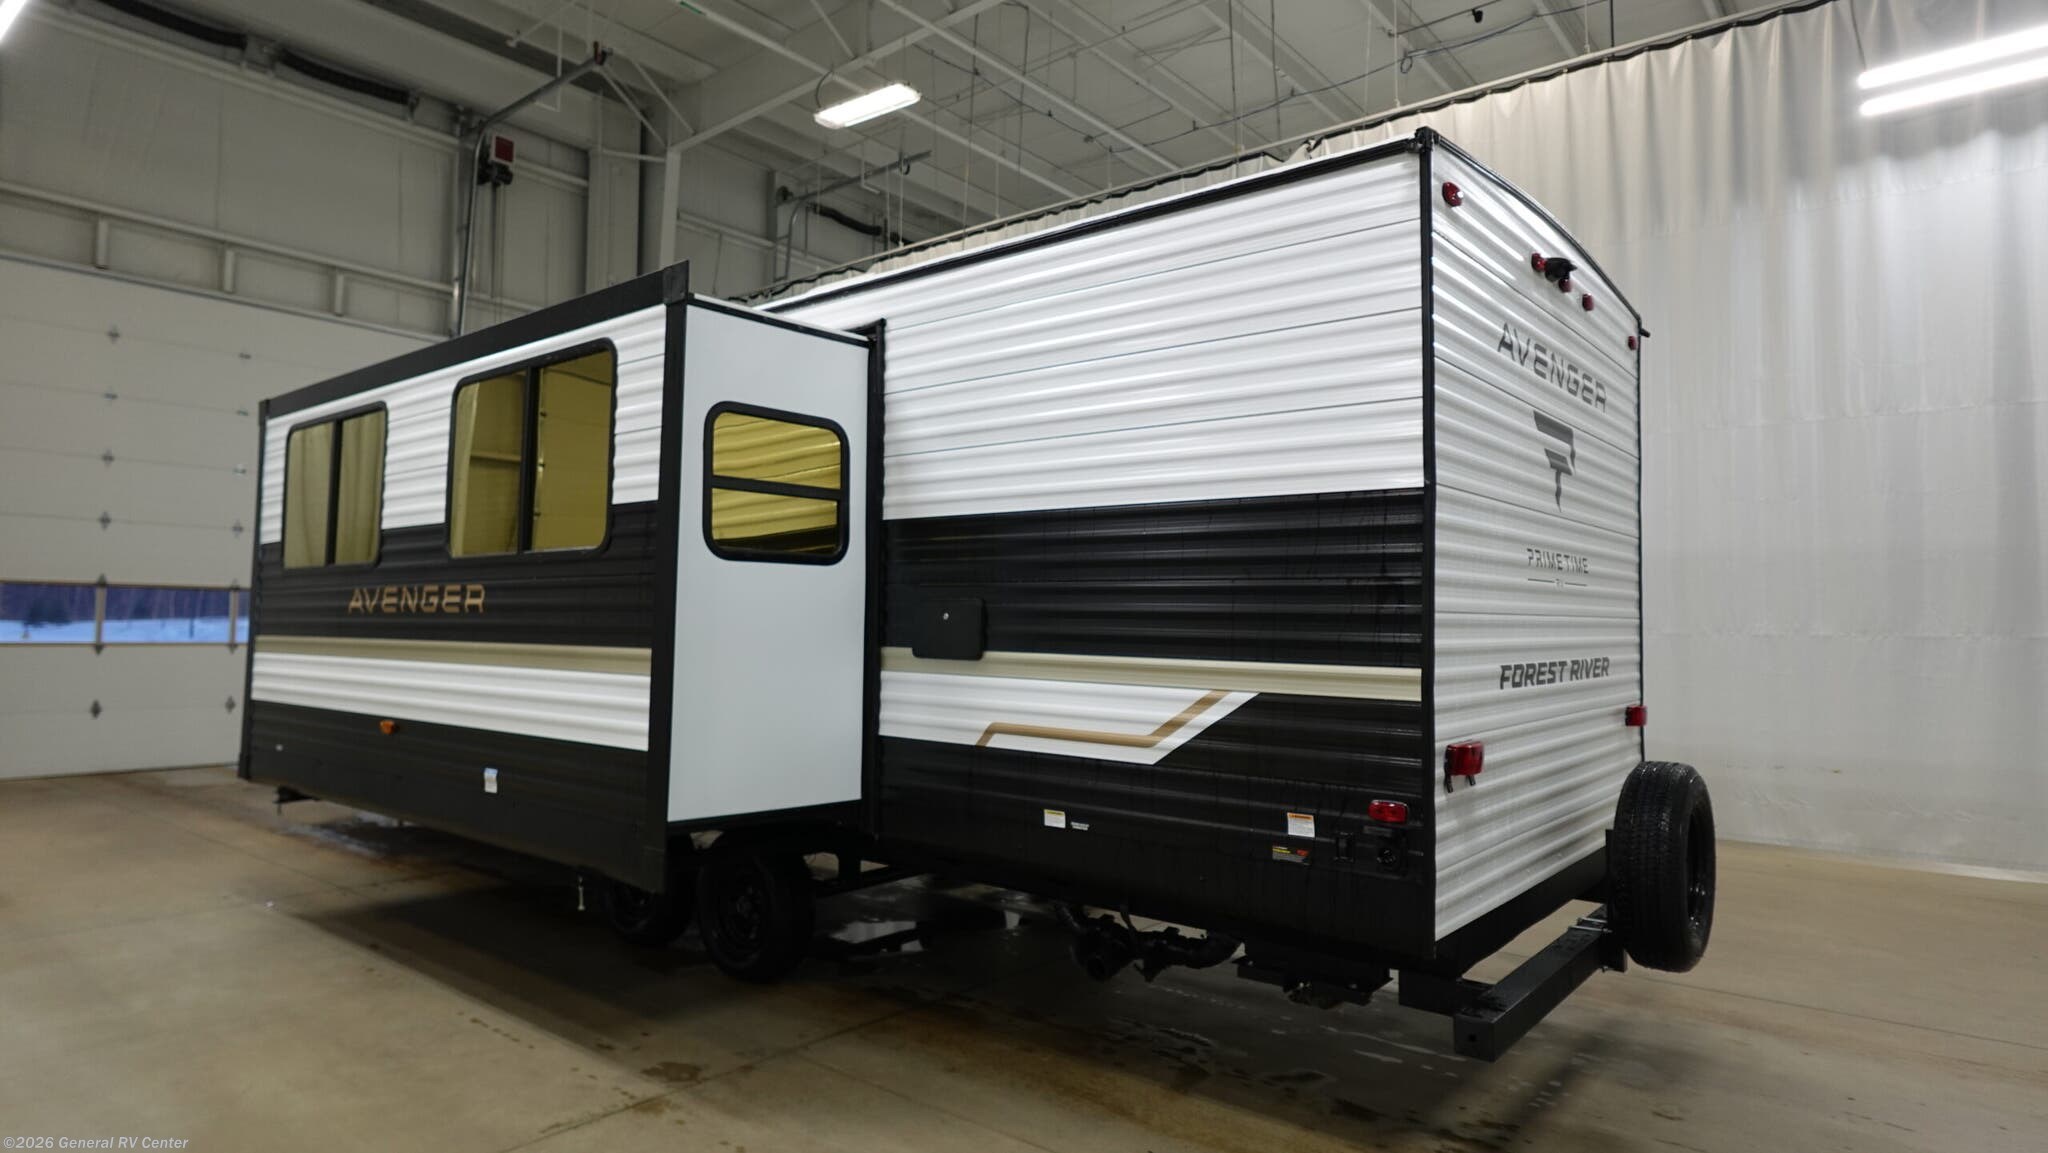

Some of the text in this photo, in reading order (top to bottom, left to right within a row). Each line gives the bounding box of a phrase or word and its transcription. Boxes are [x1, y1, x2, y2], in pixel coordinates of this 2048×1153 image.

[1497, 322, 1607, 413] AVENGER
[348, 584, 486, 614] AVENGER
[1500, 656, 1610, 690] FOREST RIVER
